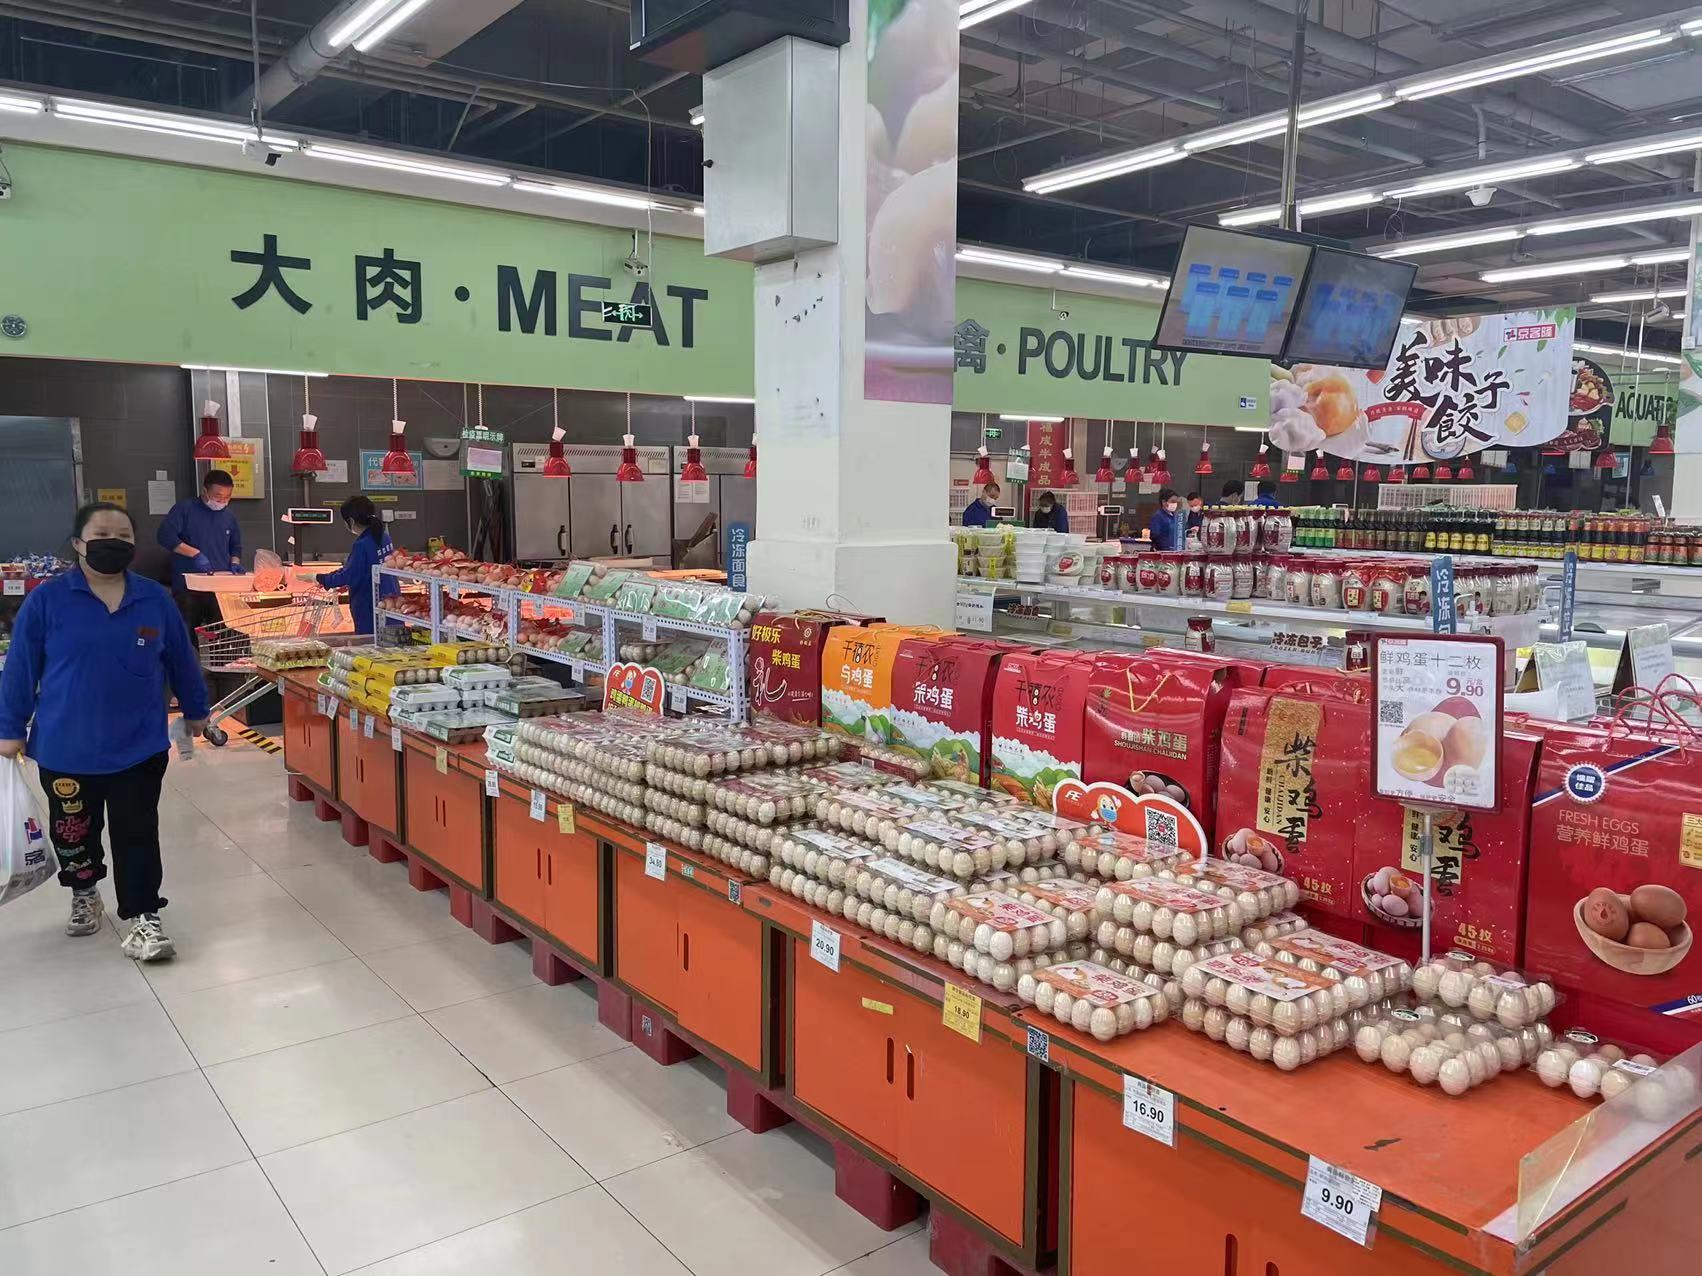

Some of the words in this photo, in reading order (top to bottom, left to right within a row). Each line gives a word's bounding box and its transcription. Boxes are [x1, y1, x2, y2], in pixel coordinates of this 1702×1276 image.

[497, 264, 708, 348] MEAT
[1018, 326, 1188, 386] POULTRY
[751, 624, 782, 644] 好极乐
[1271, 631, 1323, 650] 冷冻包子
[771, 648, 801, 670] 柴鸡蛋
[1380, 650, 1481, 670] 鲜鸡蛋十二枚
[840, 663, 874, 689] 乌鸡蛋
[913, 681, 954, 710] 柴鸡蛋
[1015, 704, 1057, 734] 柴鸡蛋
[1142, 728, 1187, 752] 柴鸡蛋
[1274, 731, 1323, 854] 柴鸡蛋
[1559, 809, 1599, 827] FRESH
[1602, 817, 1640, 835] EGGS
[1556, 824, 1649, 858] 营养鲜鸡蛋
[1458, 922, 1493, 943] 45枚
[815, 938, 834, 956] 20.90
[1132, 1099, 1165, 1124] 16.90
[1321, 1187, 1354, 1215] 9.90
